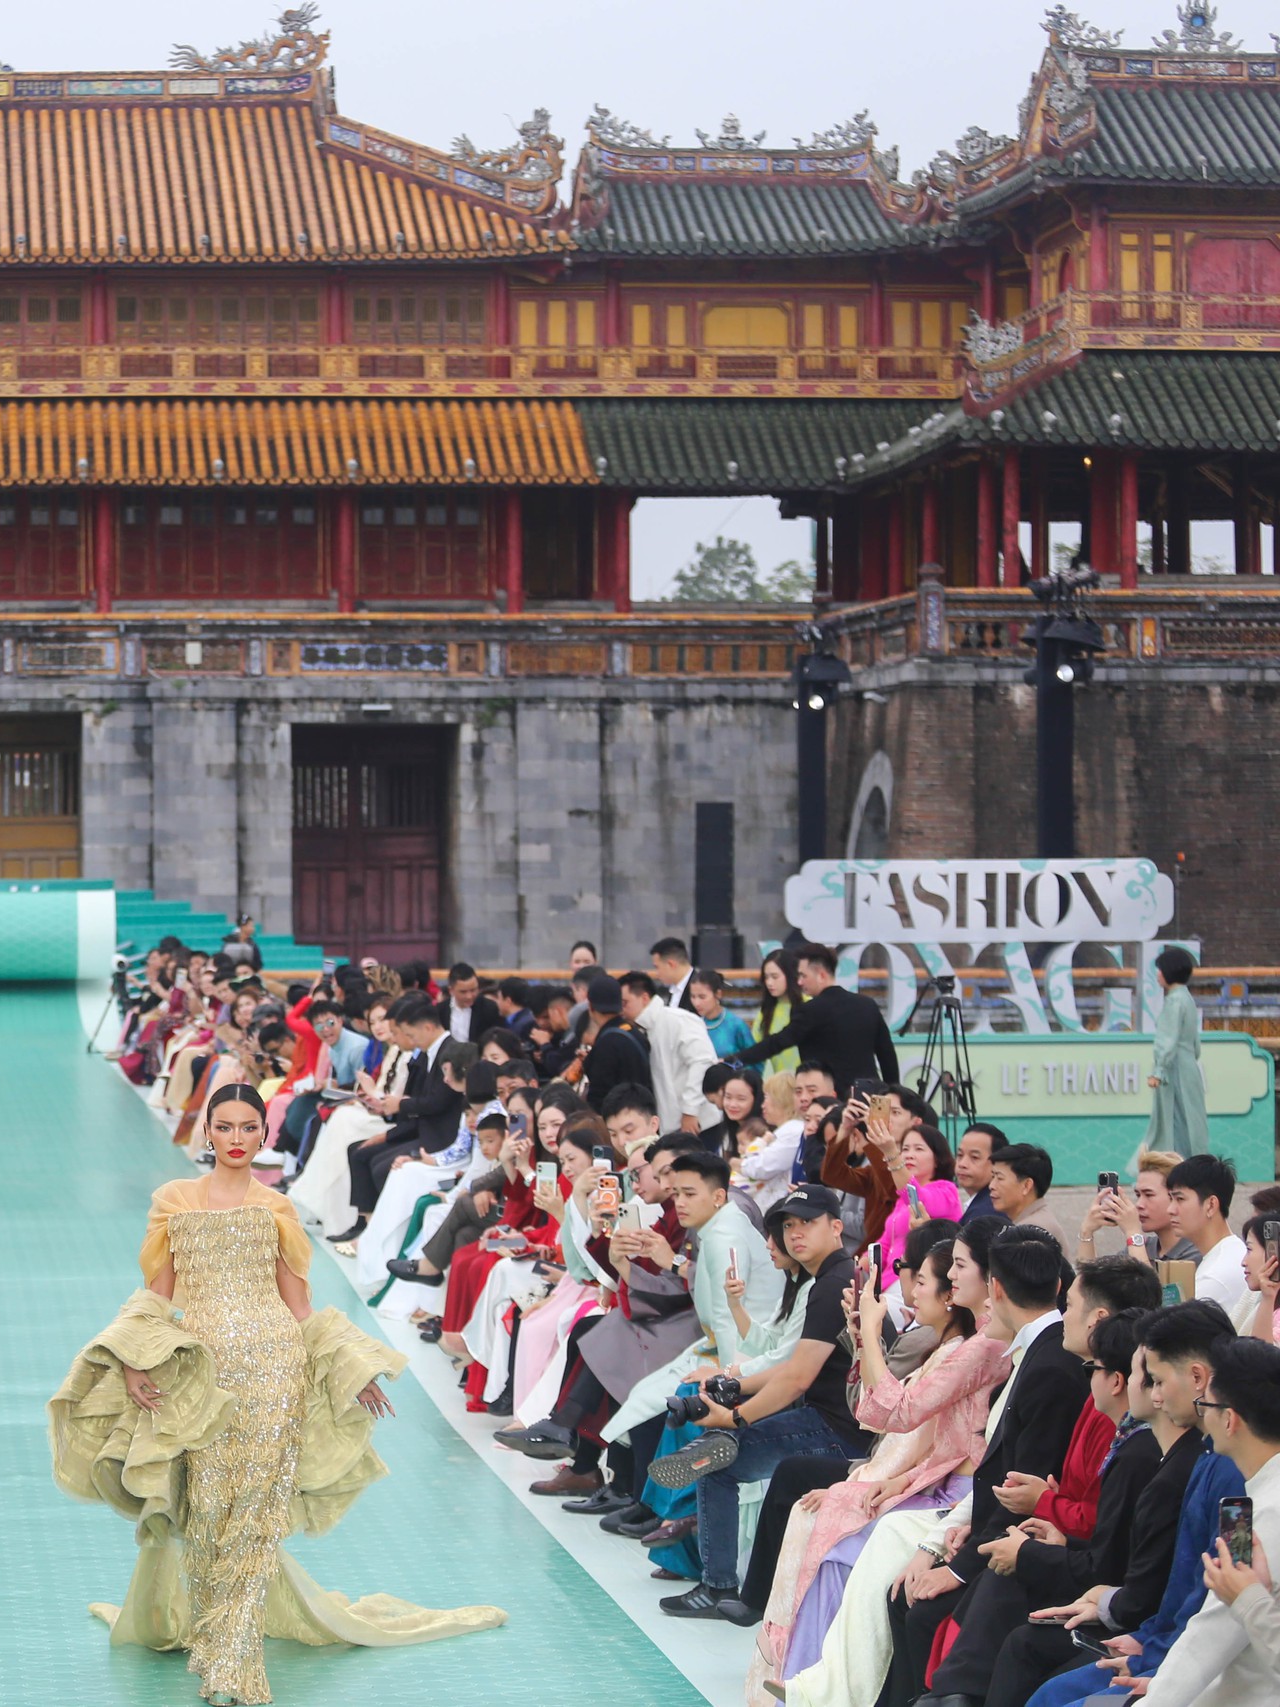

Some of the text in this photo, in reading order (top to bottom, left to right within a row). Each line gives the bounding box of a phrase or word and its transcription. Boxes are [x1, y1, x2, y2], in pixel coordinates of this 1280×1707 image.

[844, 871, 1117, 929] FASHION
[1001, 1062, 1139, 1095] LE THANH
